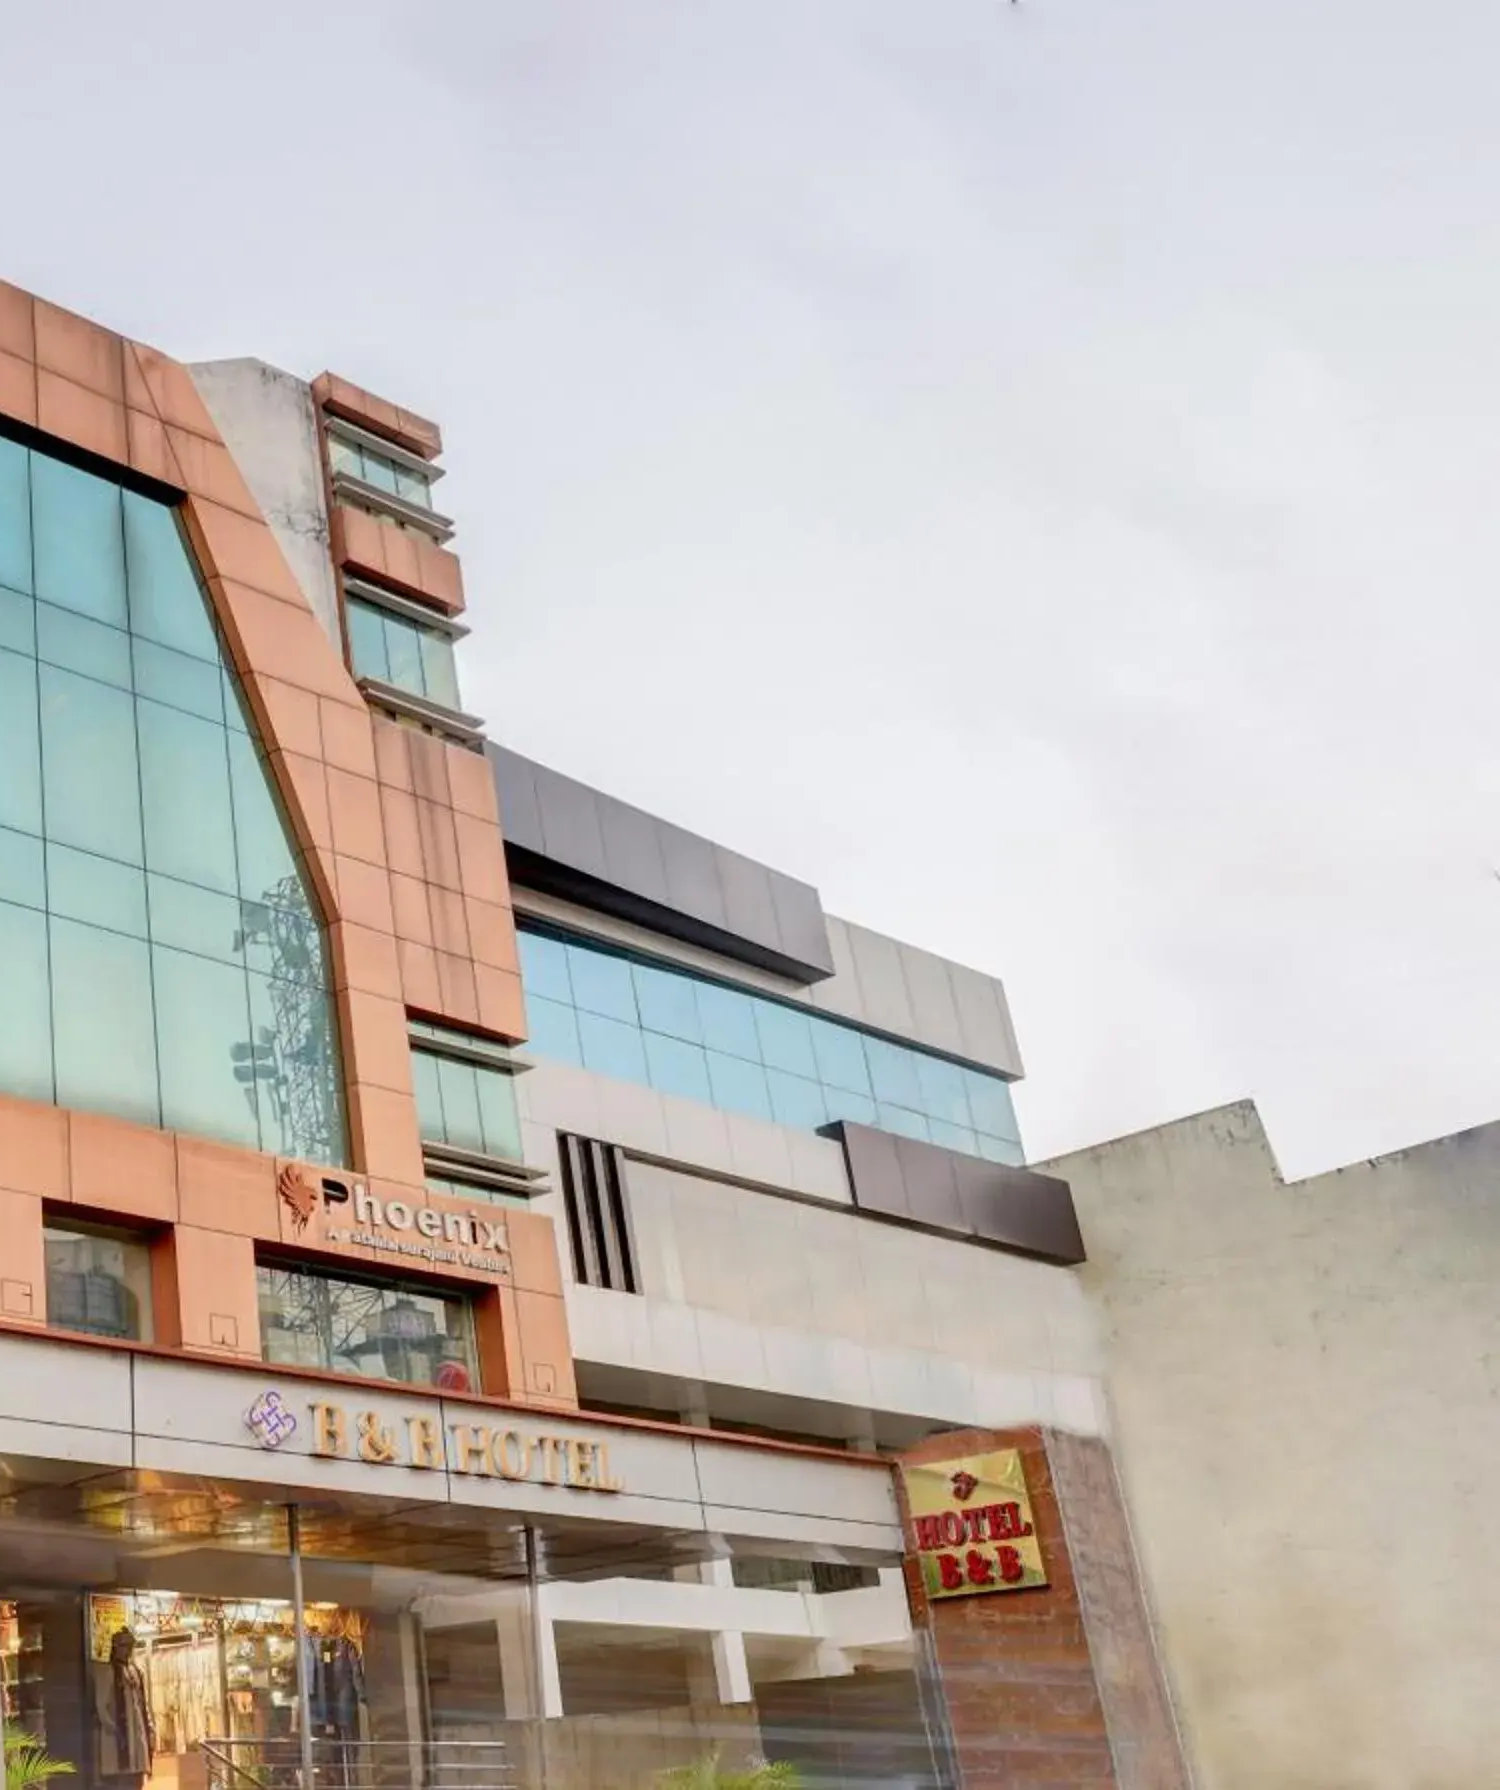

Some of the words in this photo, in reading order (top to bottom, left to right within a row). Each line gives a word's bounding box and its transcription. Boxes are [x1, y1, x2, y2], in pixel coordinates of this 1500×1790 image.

[322, 1177, 509, 1251] Phoenix
[309, 1403, 349, 1457] B
[356, 1409, 394, 1462] &
[449, 1422, 624, 1493] HOTEL
[912, 1502, 1032, 1550] HOTEL
[936, 1545, 1024, 1590] B&B
